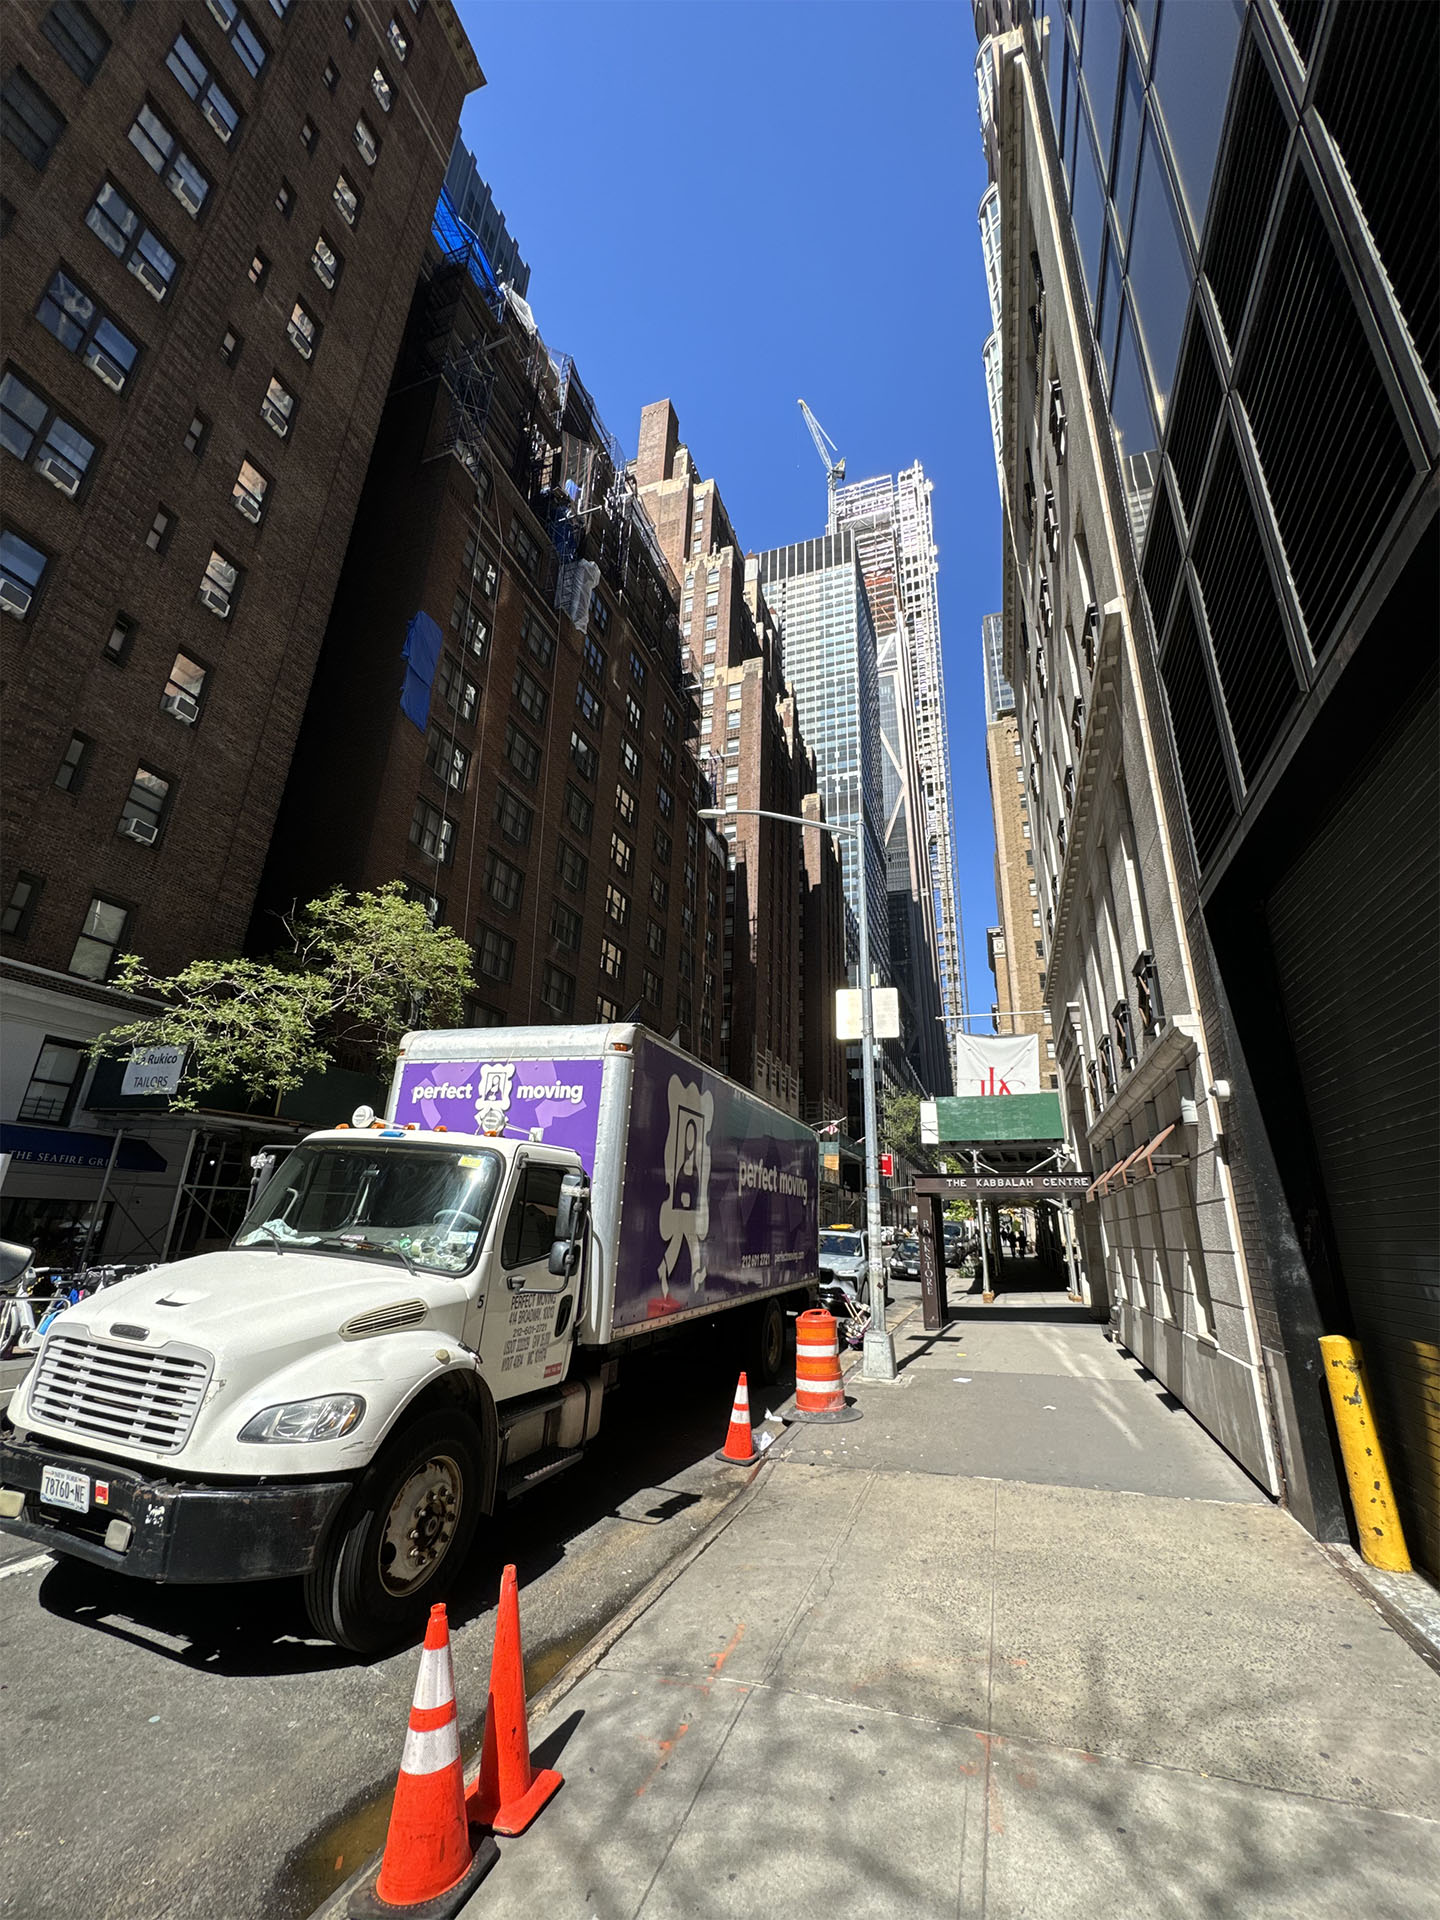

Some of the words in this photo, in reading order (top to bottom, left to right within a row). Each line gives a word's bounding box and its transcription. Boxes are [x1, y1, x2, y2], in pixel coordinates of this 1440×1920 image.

[148, 1053, 178, 1064] Rukico
[133, 1076, 169, 1088] TAILORS
[412, 1082, 474, 1103] perfect
[516, 1080, 584, 1103] moving
[8, 1150, 33, 1160] THE
[37, 1152, 85, 1164] SEAFIRE
[88, 1157, 120, 1168] GRIL
[738, 1158, 778, 1197] perfect
[779, 1169, 808, 1206] moving
[946, 1179, 967, 1187] THE
[976, 1178, 1034, 1187] KABBALAH
[1043, 1177, 1089, 1186] CENTRE
[922, 1219, 934, 1296] BOOKSTORE
[477, 1294, 485, 1309] 5
[511, 1294, 536, 1310] PERFECT
